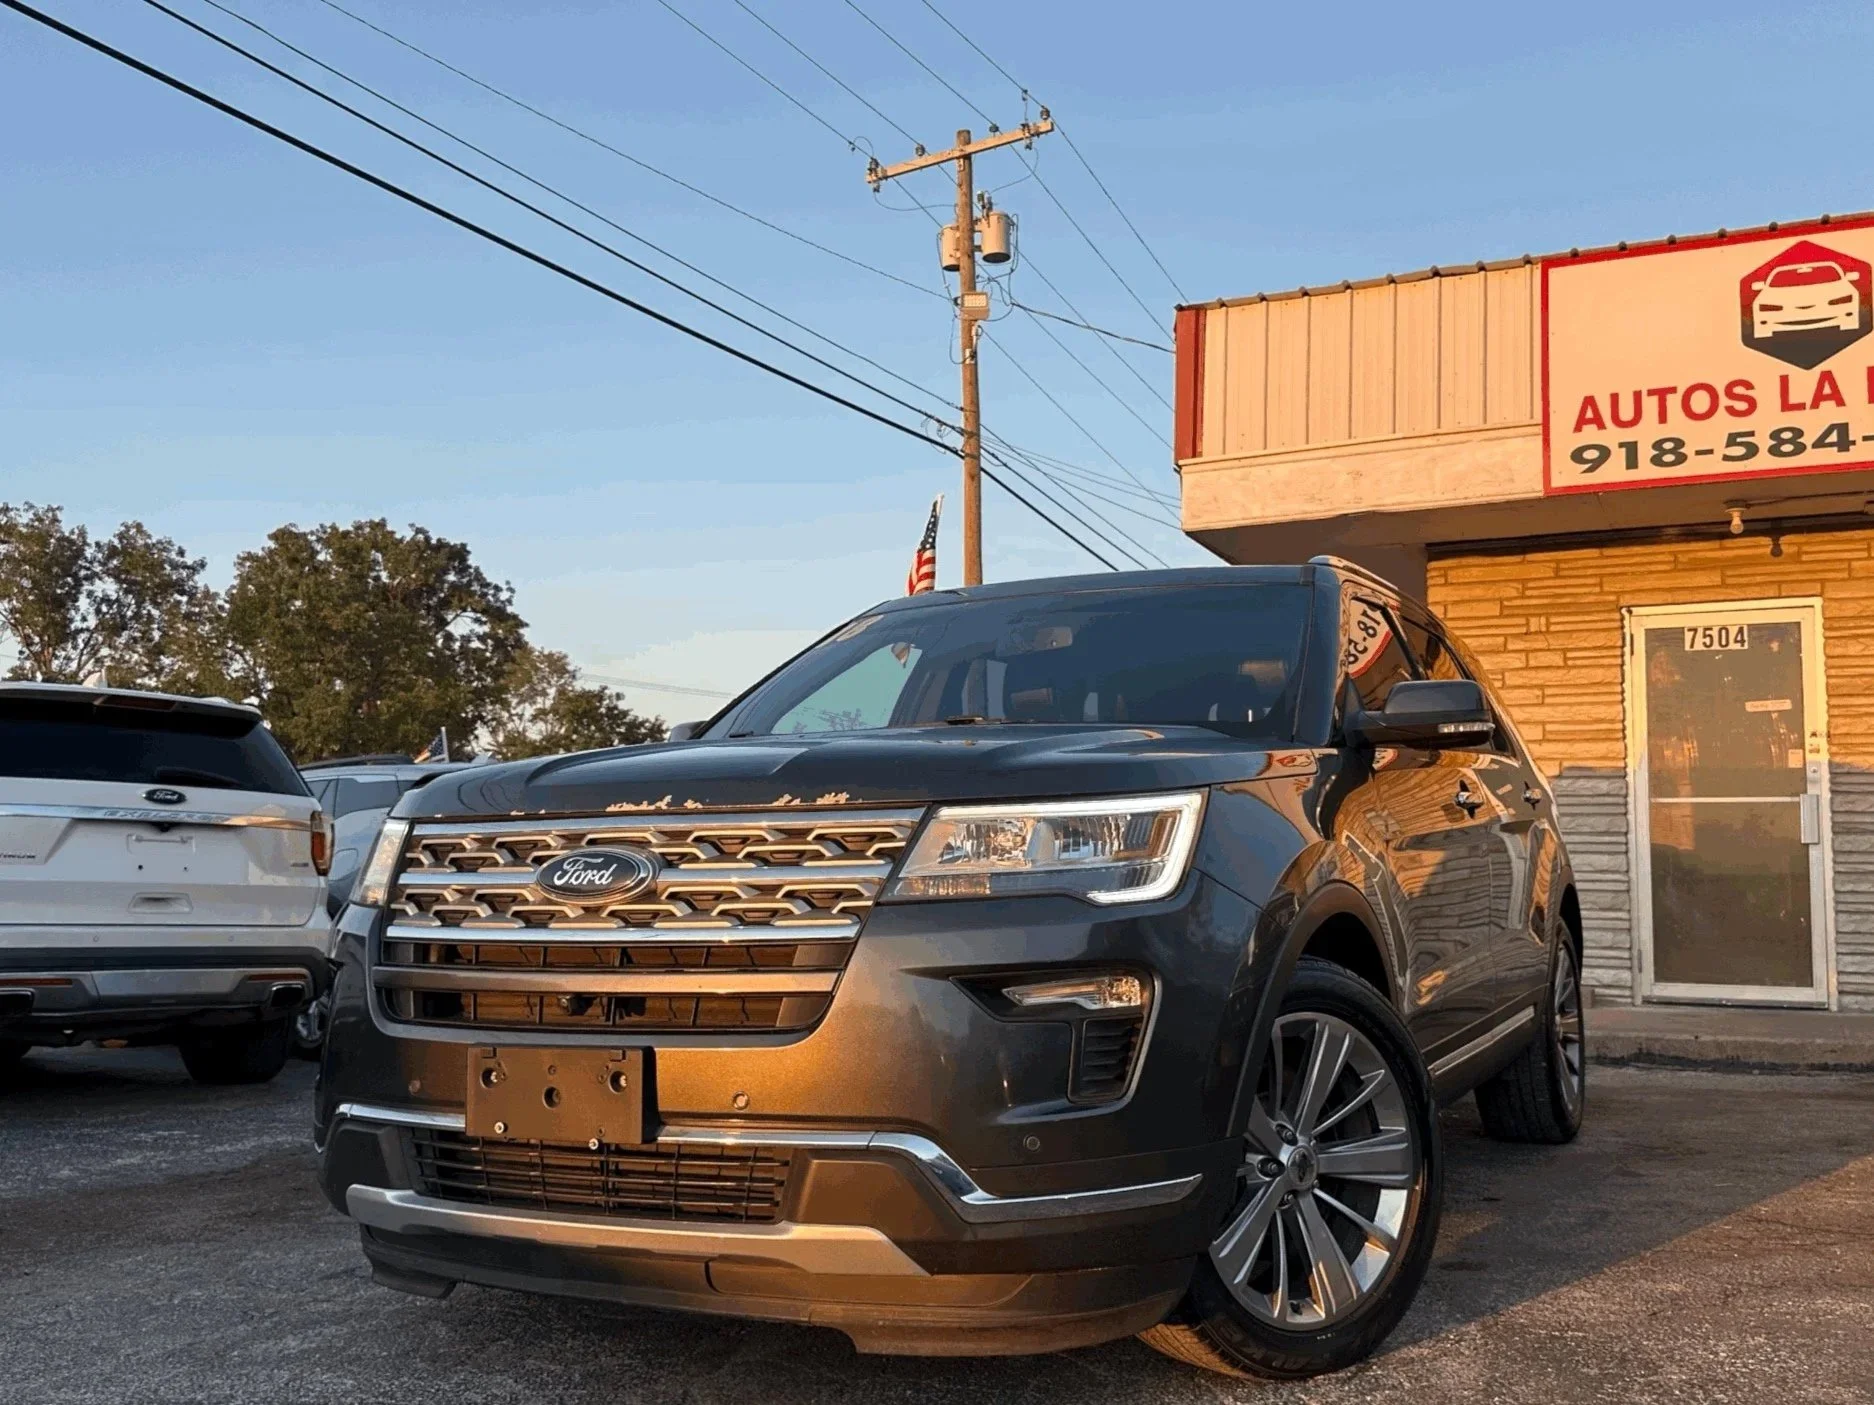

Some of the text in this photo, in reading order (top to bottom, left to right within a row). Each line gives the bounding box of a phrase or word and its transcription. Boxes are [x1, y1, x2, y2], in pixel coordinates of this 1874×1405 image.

[1572, 378, 1758, 434] AUTOS
[1779, 370, 1846, 413] LA
[1686, 625, 1747, 650] 7504
[553, 856, 618, 886] Ford
